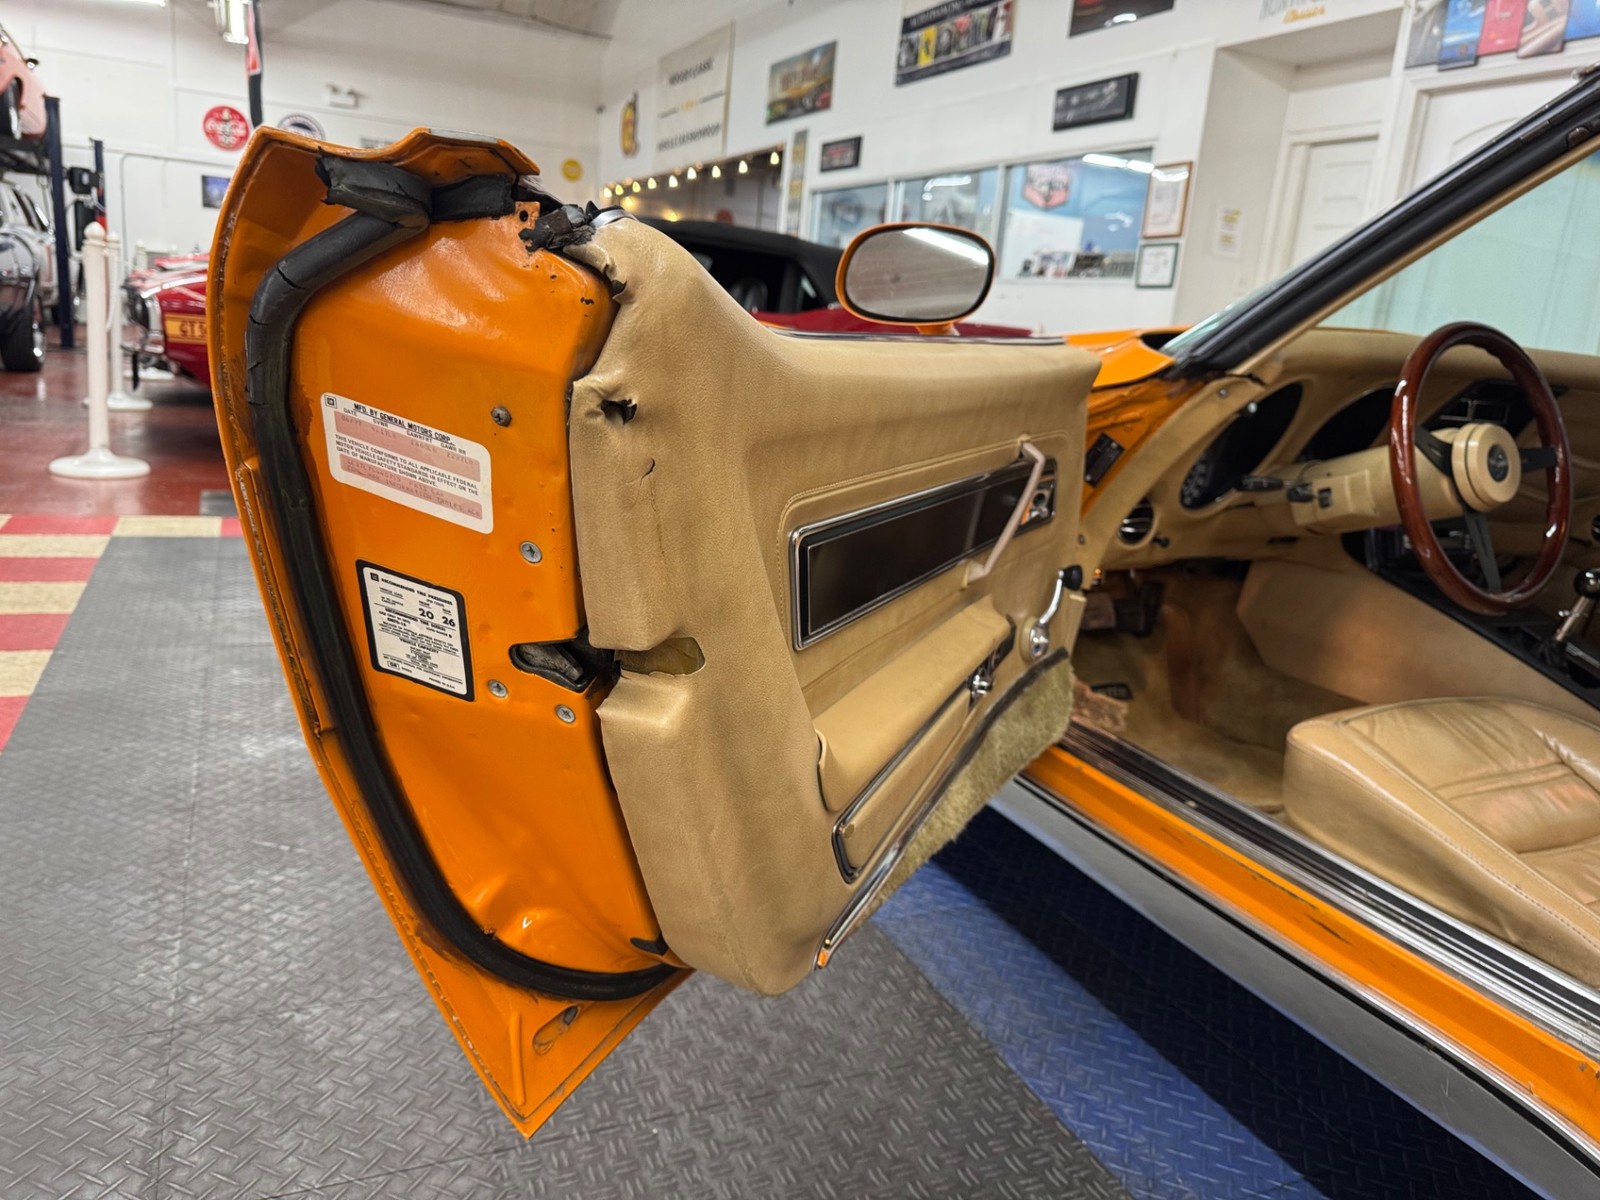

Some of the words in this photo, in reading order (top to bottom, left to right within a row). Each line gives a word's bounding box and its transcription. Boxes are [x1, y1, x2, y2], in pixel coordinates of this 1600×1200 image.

[344, 408, 357, 416] DATE
[354, 404, 368, 414] MFD.
[370, 409, 377, 417] BY
[380, 413, 404, 427] GENERAL
[408, 423, 432, 437] MOTORS
[435, 432, 452, 444] CORP.
[336, 440, 353, 450] MOTOR
[355, 447, 376, 459] VEHICLE
[377, 455, 396, 466] SAFETY
[397, 463, 428, 478] STANDARDS
[437, 477, 456, 488] EFFECT
[468, 488, 478, 496] THE
[337, 446, 350, 455] DATE
[360, 455, 396, 472] MANUFACTURE
[399, 469, 416, 479] SHOWN
[419, 476, 438, 487] ABOVE.
[348, 439, 369, 450] VEHICLE
[371, 447, 398, 461] CONFORMS
[420, 465, 451, 480] APPLICABLE
[453, 477, 477, 490] FEDERAL
[419, 608, 434, 621] 20
[442, 616, 456, 628] 26
